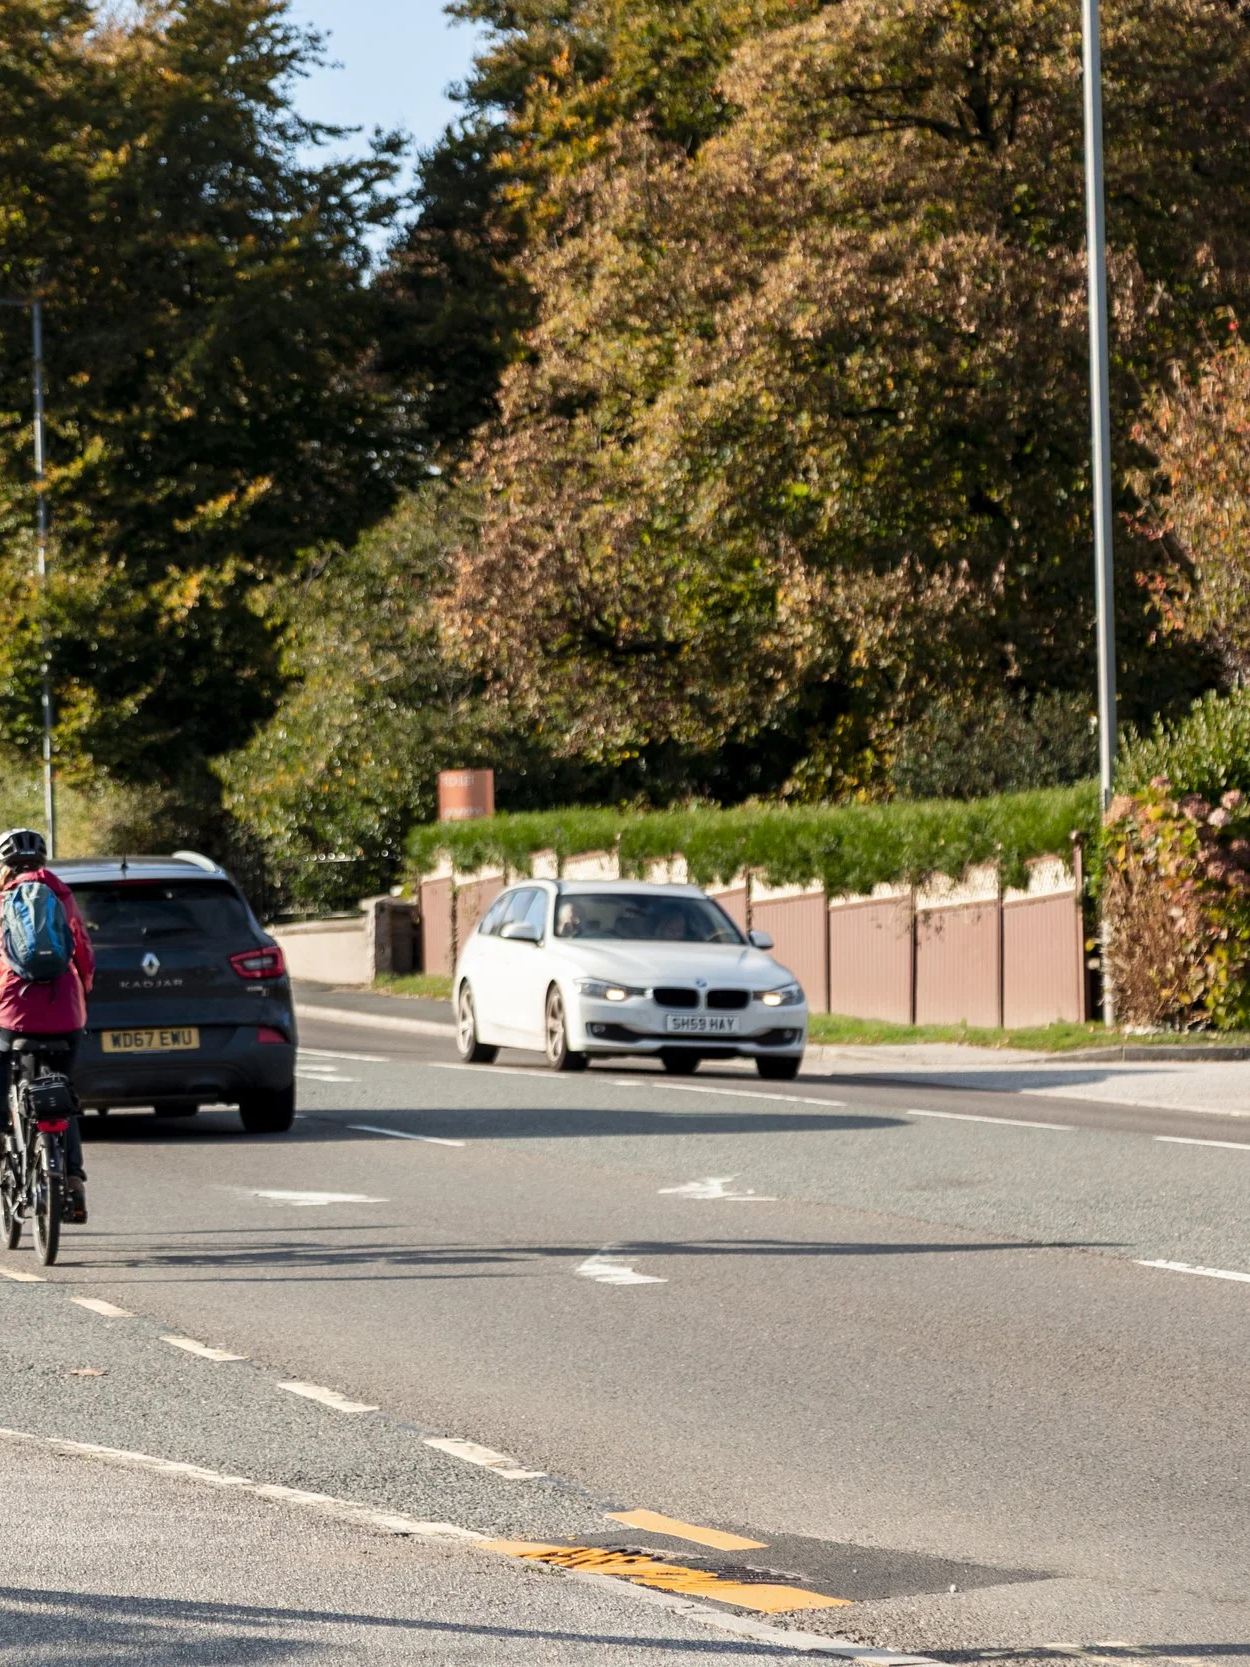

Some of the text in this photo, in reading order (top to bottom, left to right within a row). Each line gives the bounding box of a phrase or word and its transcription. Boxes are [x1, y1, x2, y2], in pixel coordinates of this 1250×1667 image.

[120, 979, 183, 988] KADJAR
[672, 1017, 735, 1031] SH59 HAY
[111, 1029, 193, 1049] WD67 EWU
